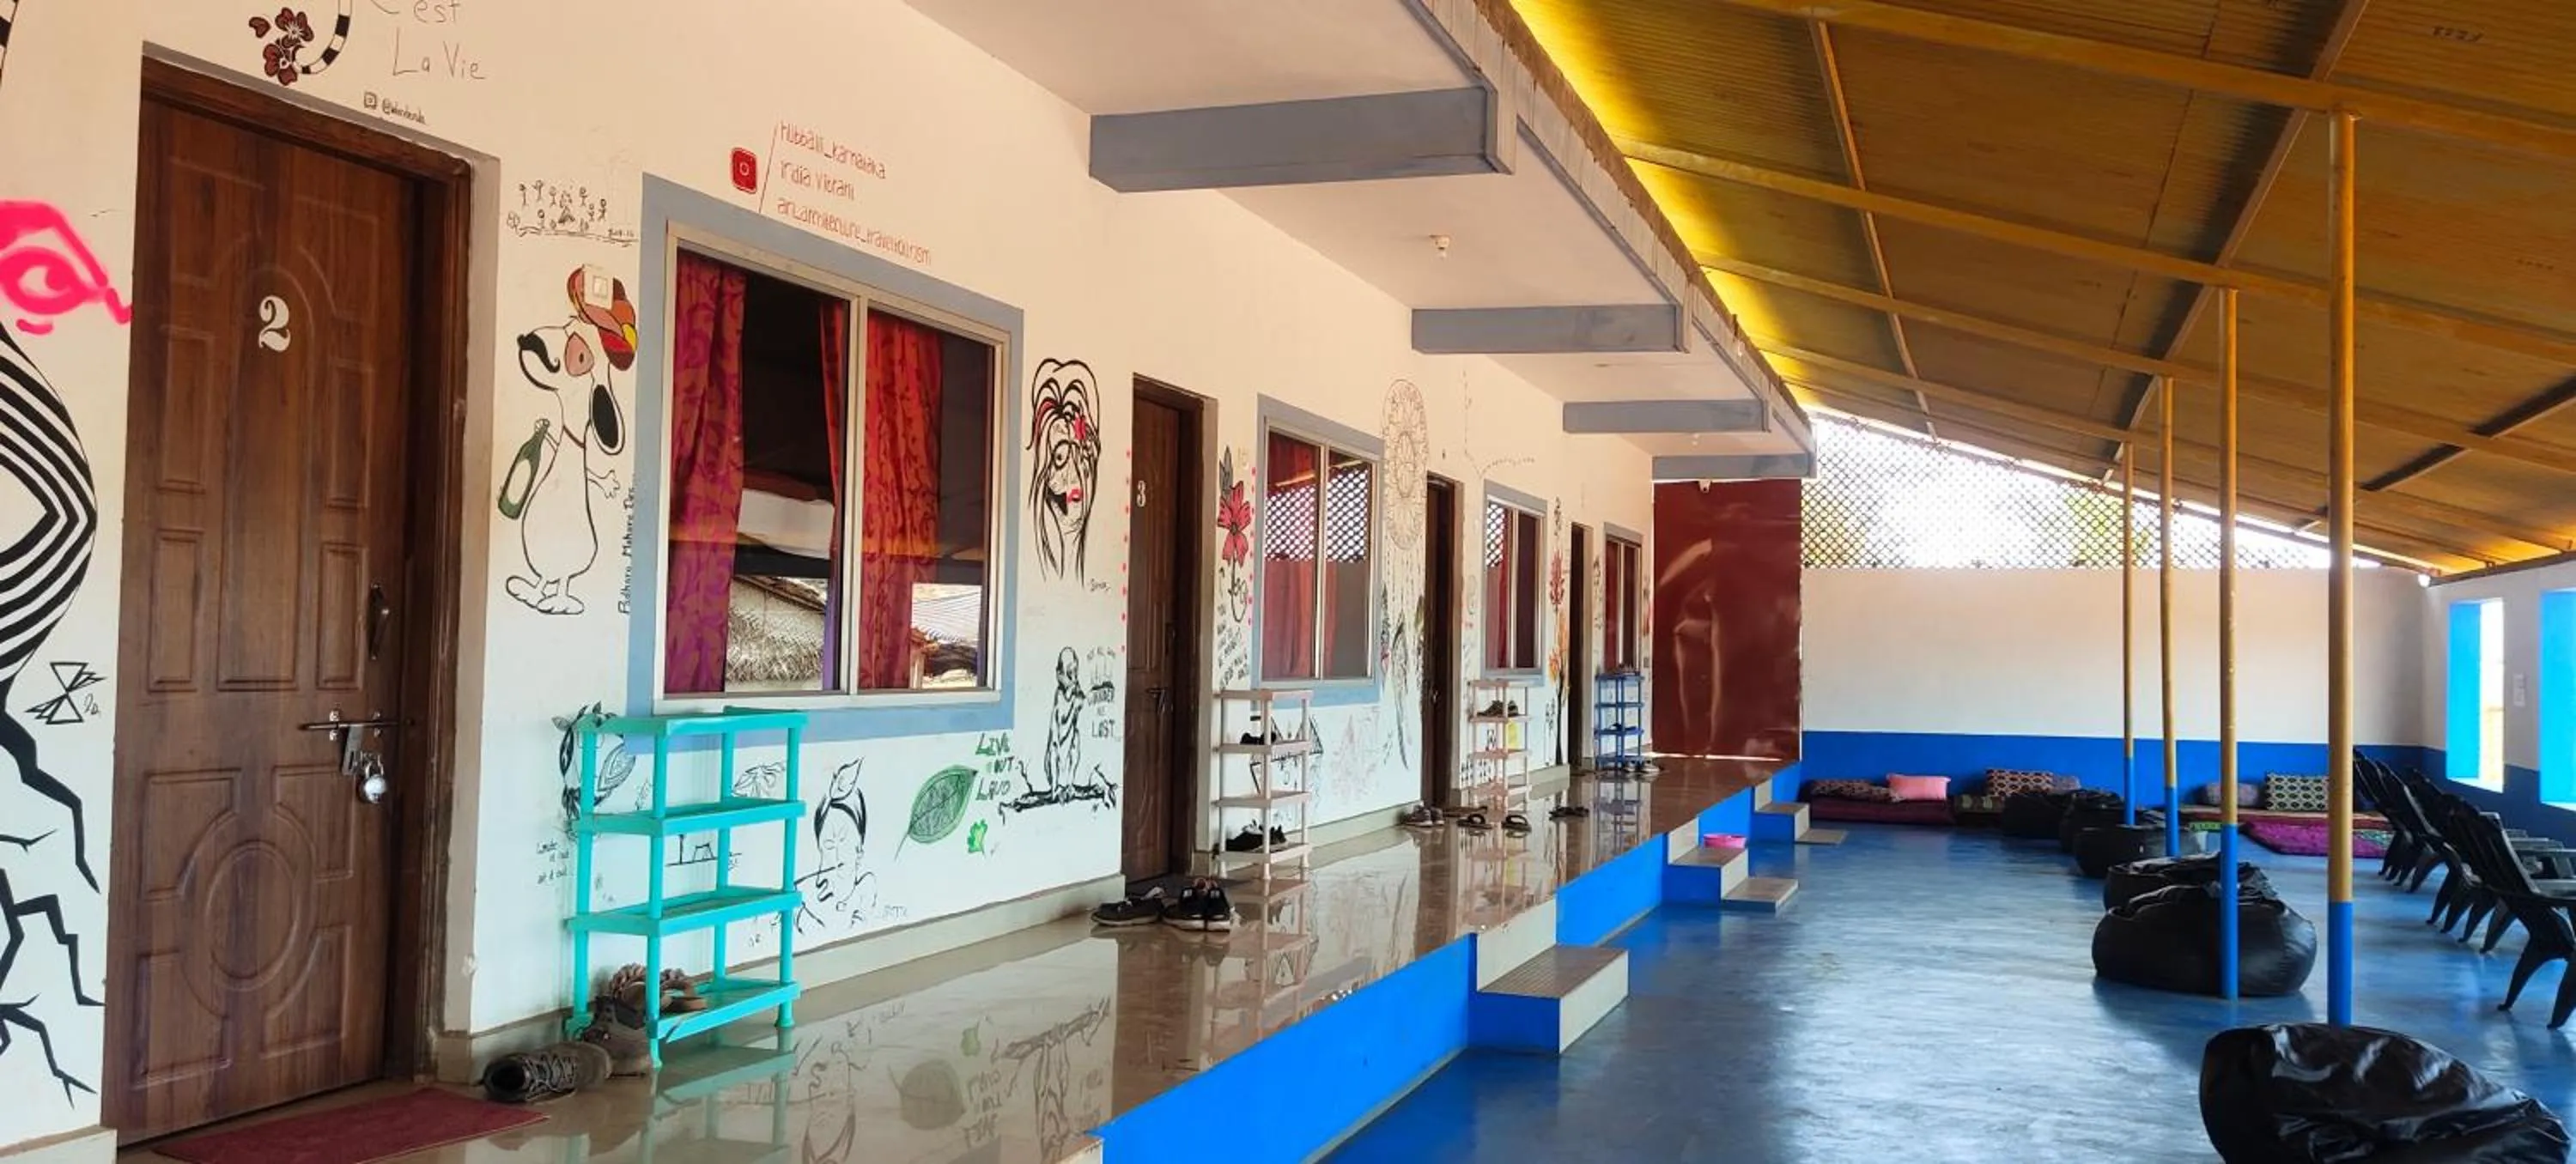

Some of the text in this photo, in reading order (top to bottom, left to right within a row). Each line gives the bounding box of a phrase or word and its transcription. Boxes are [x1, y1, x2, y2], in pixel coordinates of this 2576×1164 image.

[392, 27, 487, 80] La Vie
[258, 295, 291, 352] 2
[1137, 480, 1146, 507] 3
